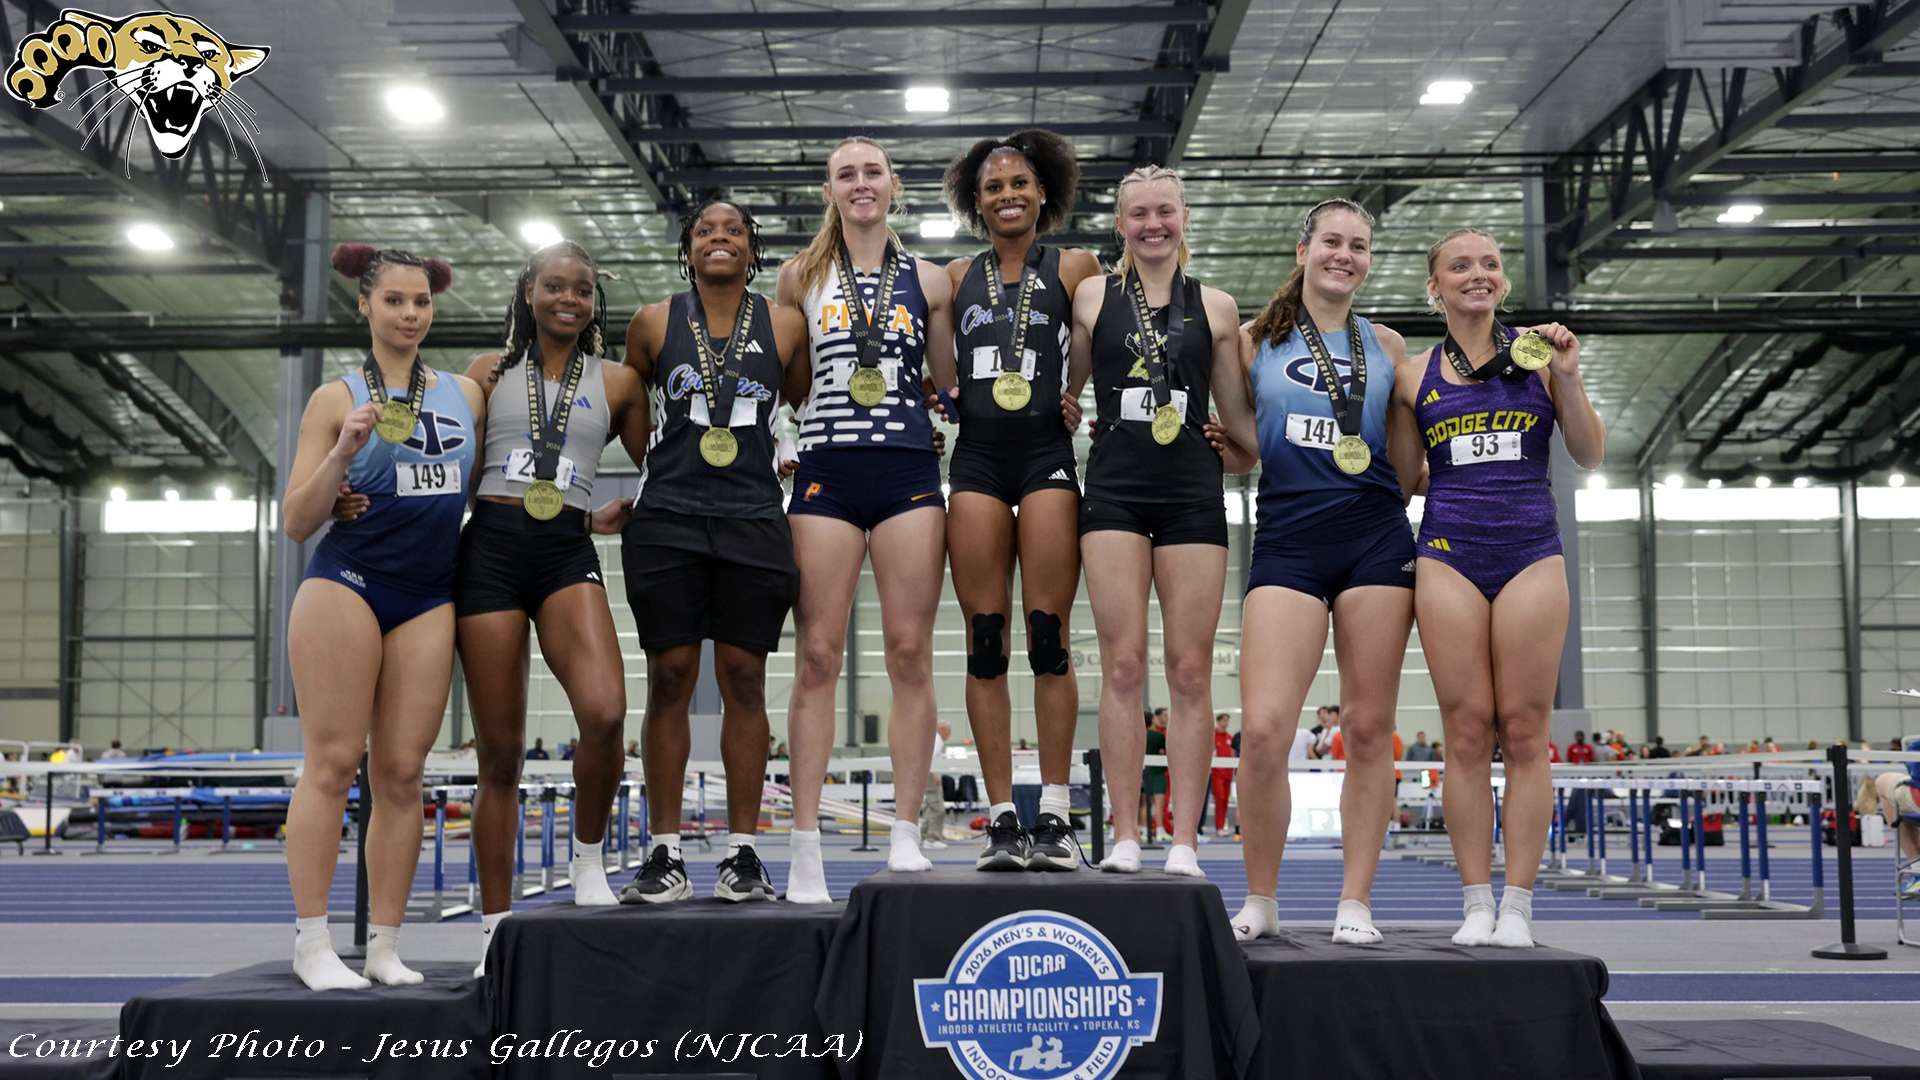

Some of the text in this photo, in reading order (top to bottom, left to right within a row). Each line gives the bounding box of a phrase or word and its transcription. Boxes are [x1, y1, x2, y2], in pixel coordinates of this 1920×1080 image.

[1015, 273, 1036, 358] ALL-AMERICAN
[1300, 324, 1339, 400] ALL-AMERICAN
[527, 360, 540, 440] ALL-AMERICAN
[557, 356, 583, 432] ALL-AMERICAN
[1302, 418, 1335, 445] 141
[1425, 412, 1489, 449] DODGE
[1491, 410, 1539, 432] CITY
[1472, 434, 1499, 458] 93
[410, 463, 446, 490] 149
[965, 926, 1110, 977] 2026 MEN'S & WOMEN'S
[1008, 954, 1066, 983] NJCAA
[944, 984, 1133, 1022] CHAMPIONSHIPS
[938, 1019, 1141, 1035] INDOOR ATHLETIC FACILITY TOPEKA, KS
[1087, 1041, 1114, 1076] FIELD
